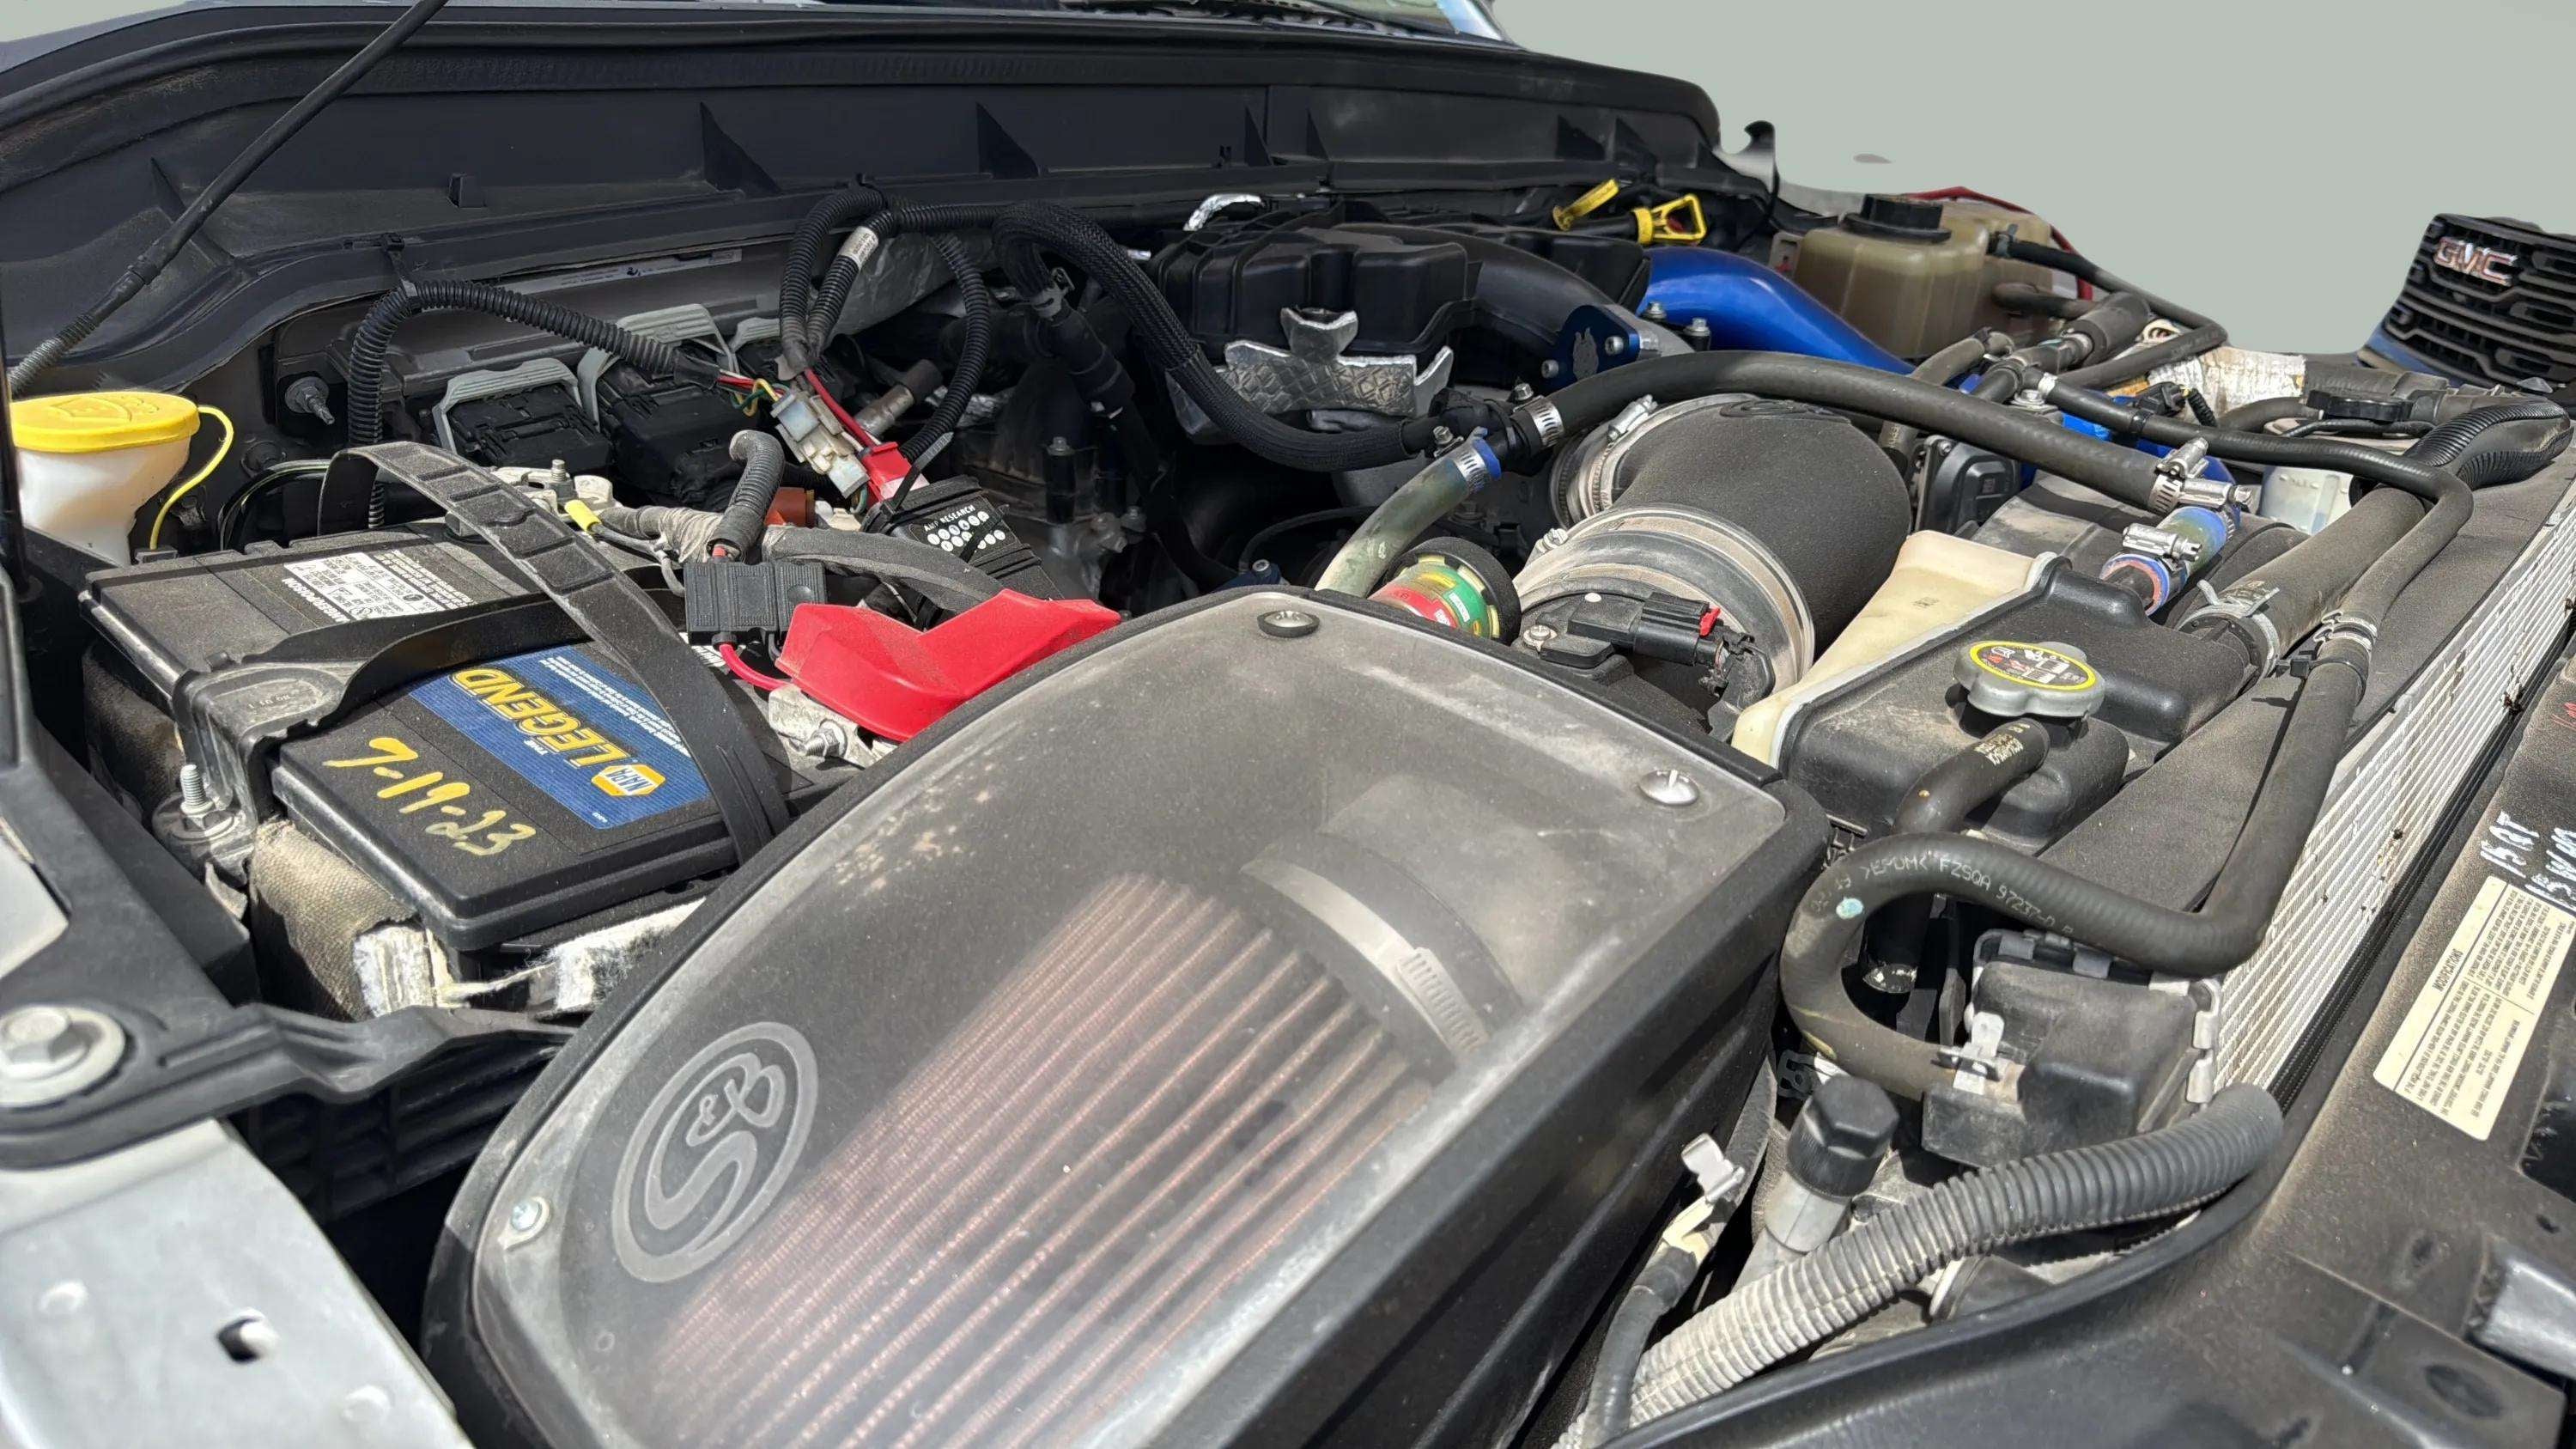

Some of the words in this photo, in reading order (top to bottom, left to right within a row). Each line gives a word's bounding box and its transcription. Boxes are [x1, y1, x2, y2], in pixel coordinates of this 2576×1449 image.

[2433, 236, 2518, 287] GMC
[939, 504, 975, 524] RESEARCH
[448, 667, 632, 768] LEGEND
[322, 736, 538, 856] 7-19-23
[605, 767, 654, 792] NAPA
[2434, 947, 2465, 993] MODIFICATIONS
[644, 1051, 786, 1265] S&B
